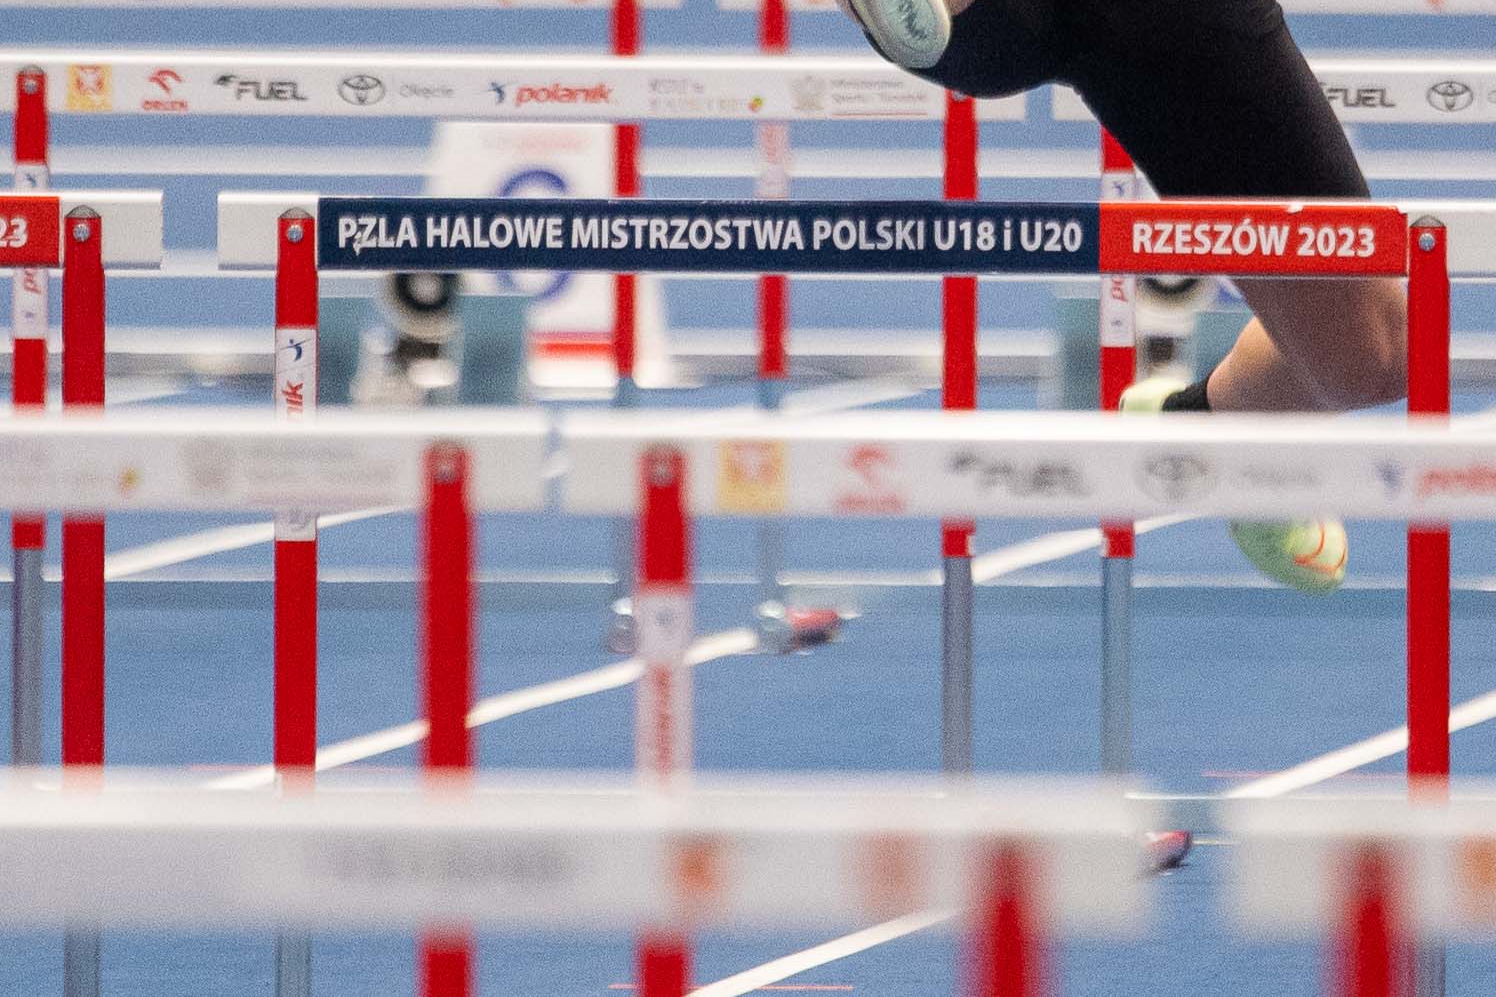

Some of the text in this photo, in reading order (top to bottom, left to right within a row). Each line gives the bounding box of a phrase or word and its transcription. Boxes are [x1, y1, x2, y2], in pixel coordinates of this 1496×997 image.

[235, 80, 308, 101] FUEL
[515, 82, 613, 106] polanik
[1327, 87, 1396, 108] FUEL
[338, 215, 1083, 252] PZLA HALOWE MISTRZOSTWA POLSKI U18 i U20
[1132, 217, 1376, 258] RZESZÓW 2023
